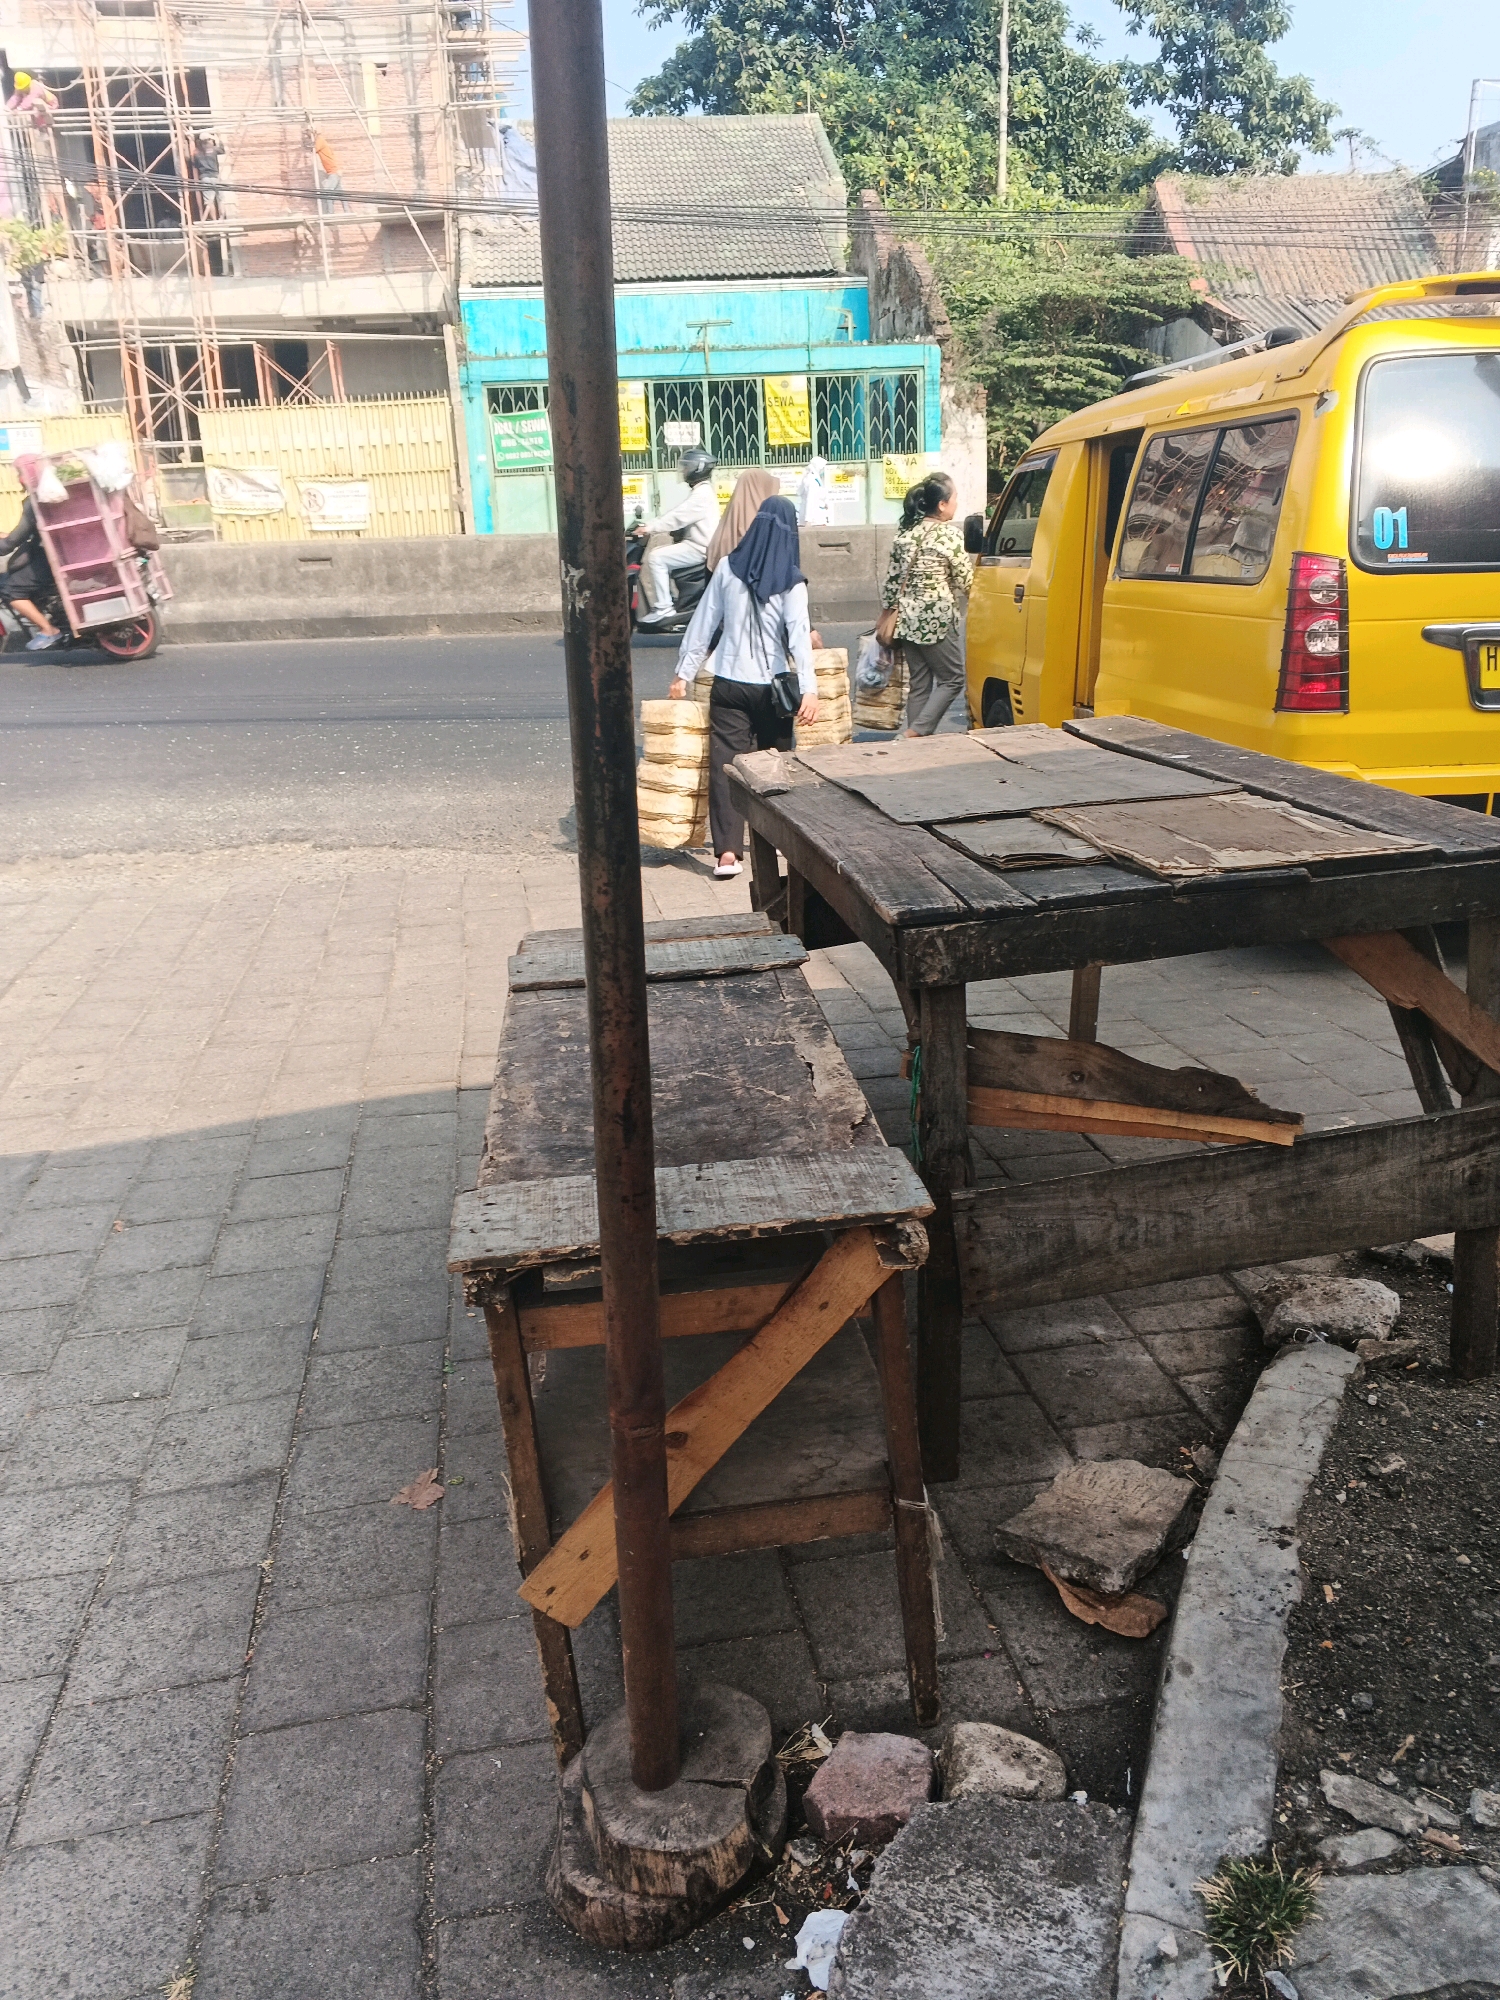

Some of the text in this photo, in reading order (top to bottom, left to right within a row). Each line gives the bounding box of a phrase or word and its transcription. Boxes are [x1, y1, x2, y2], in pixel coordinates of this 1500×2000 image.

[767, 395, 795, 408] SEWA
[520, 418, 548, 434] SEWA
[1373, 506, 1409, 550] 01
[1486, 646, 1498, 671] H
